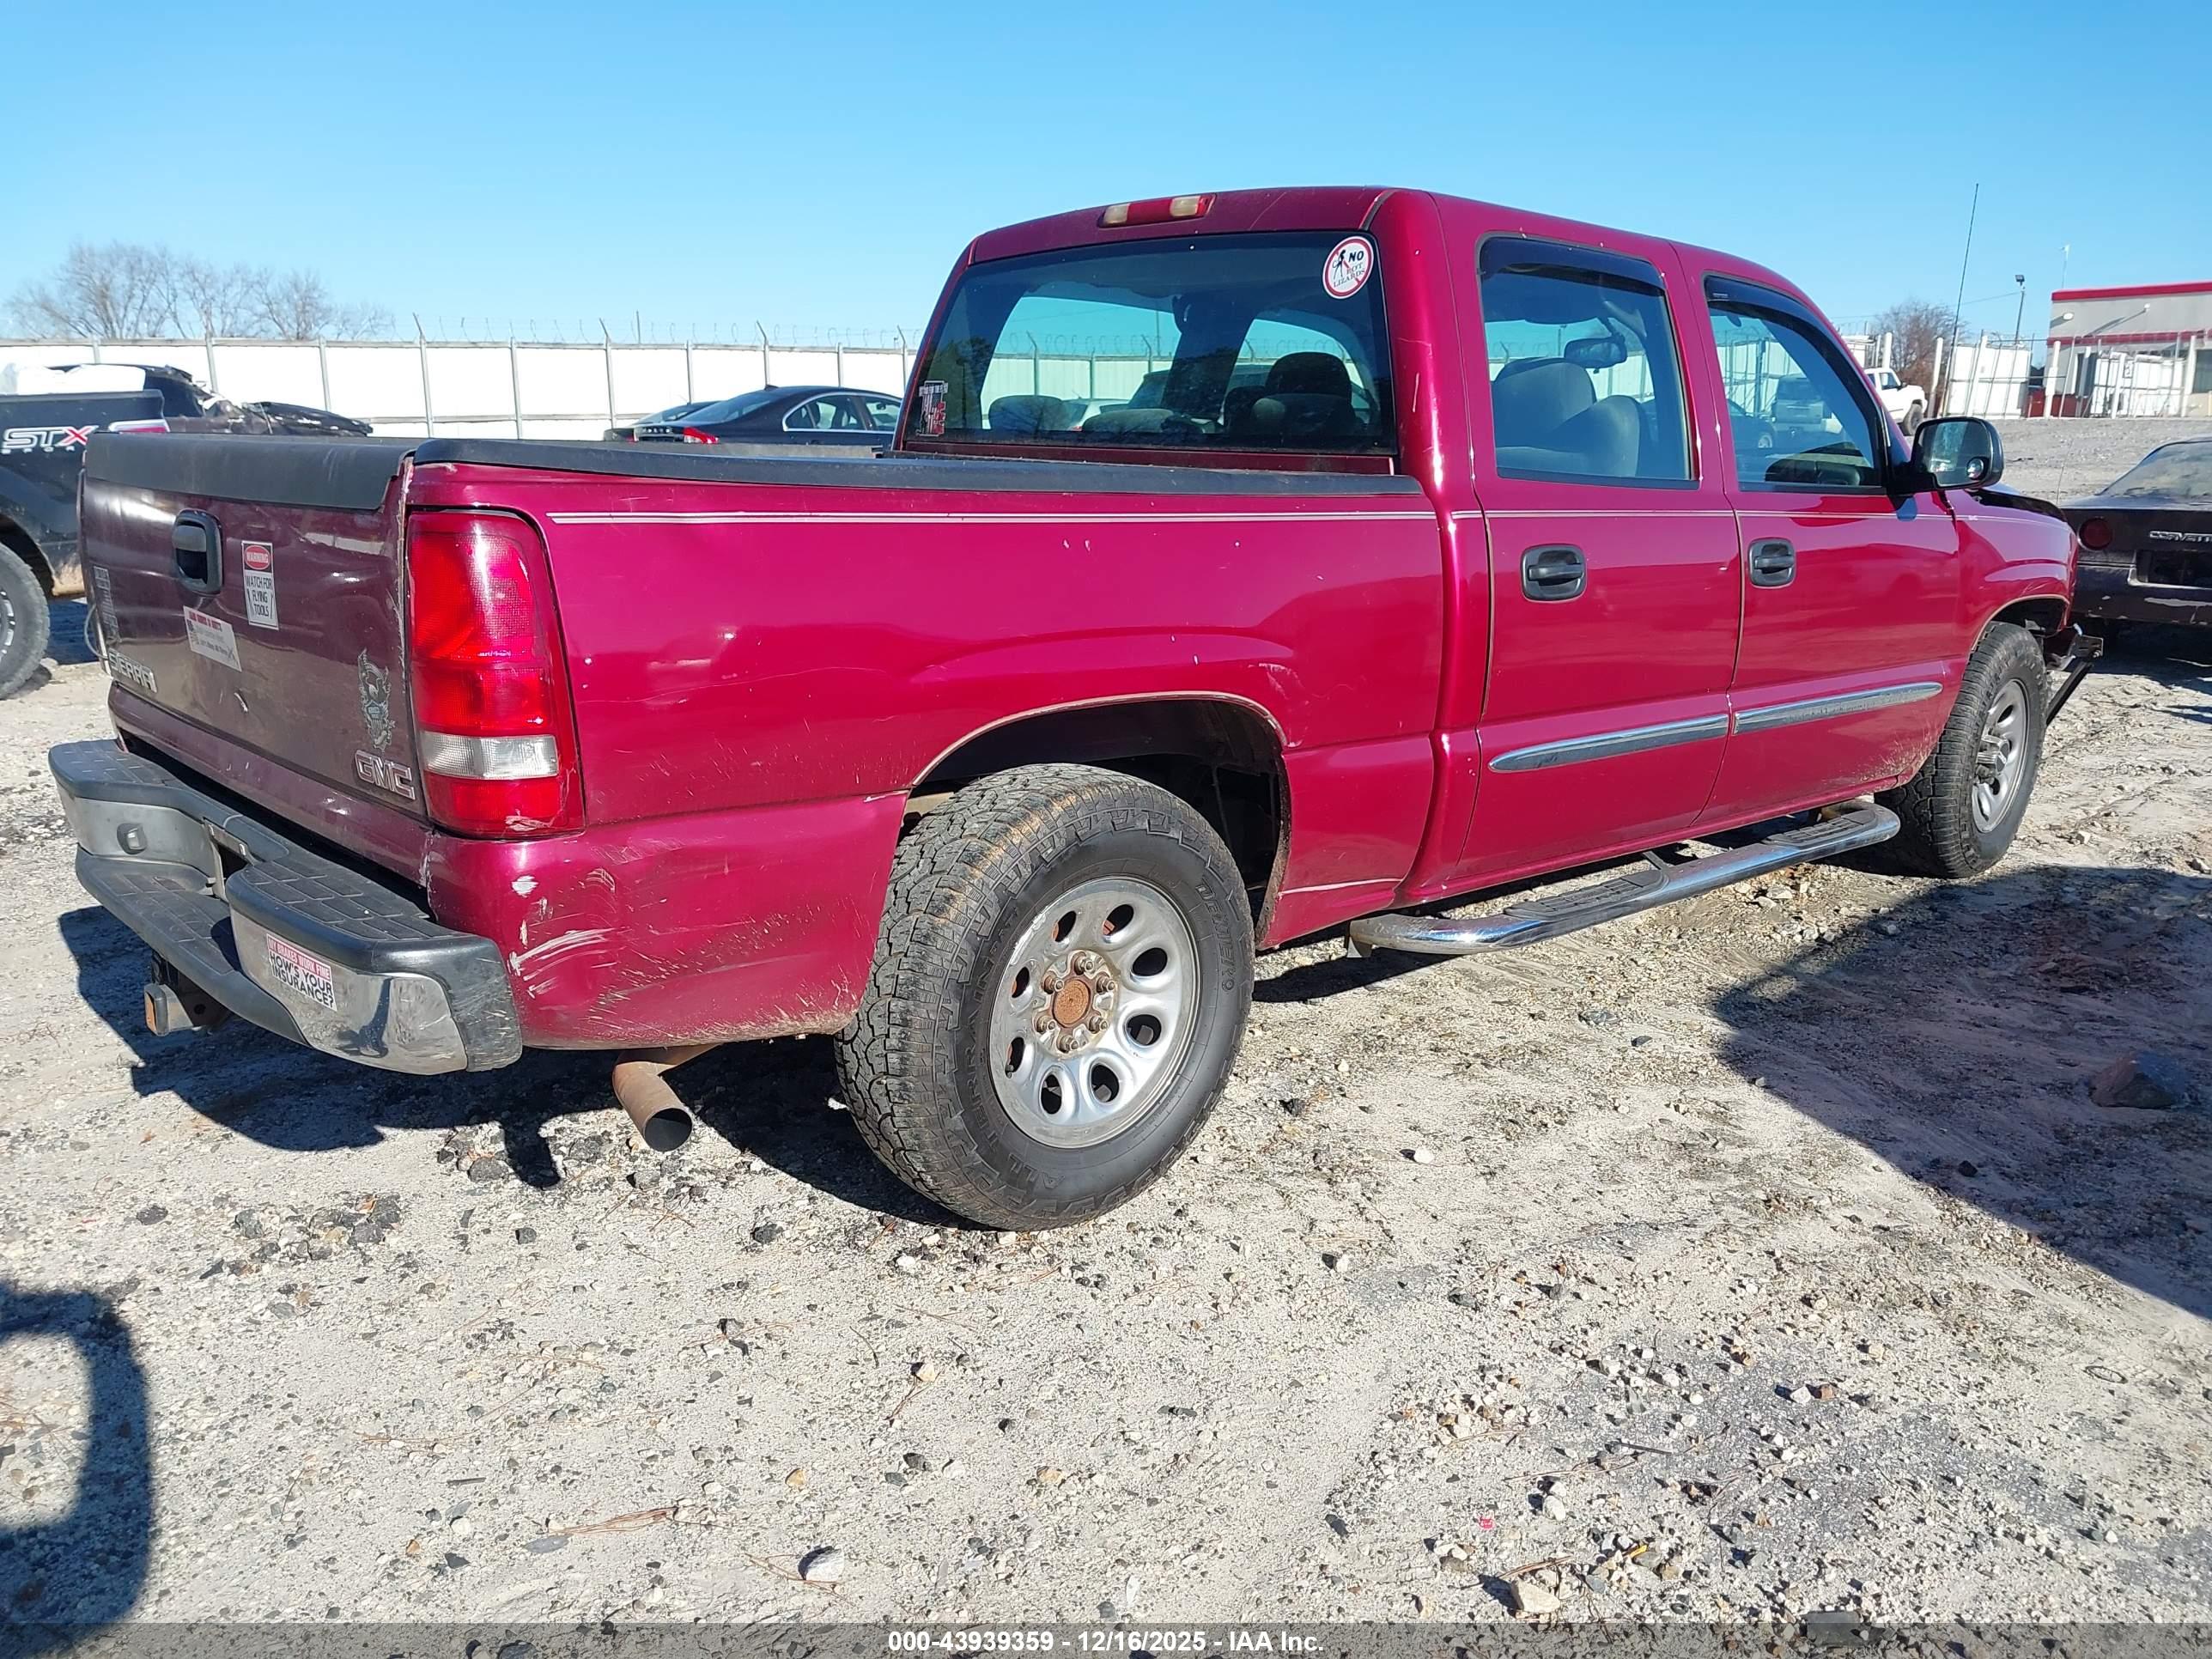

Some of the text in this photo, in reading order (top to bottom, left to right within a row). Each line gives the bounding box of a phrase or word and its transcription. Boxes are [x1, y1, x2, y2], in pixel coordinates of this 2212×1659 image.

[1349, 250, 1364, 263] NO
[3, 425, 99, 448] STX
[246, 575, 272, 591] WATCH FOR
[252, 590, 268, 603] FLYING
[253, 603, 270, 617] TOOLS
[108, 647, 158, 693] SIERRA
[355, 749, 416, 800] GMC
[269, 939, 331, 980] MY BRAKES WORK FINE
[270, 951, 332, 997] HOW'S YOUR
[271, 965, 335, 1008] INSURANCE?
